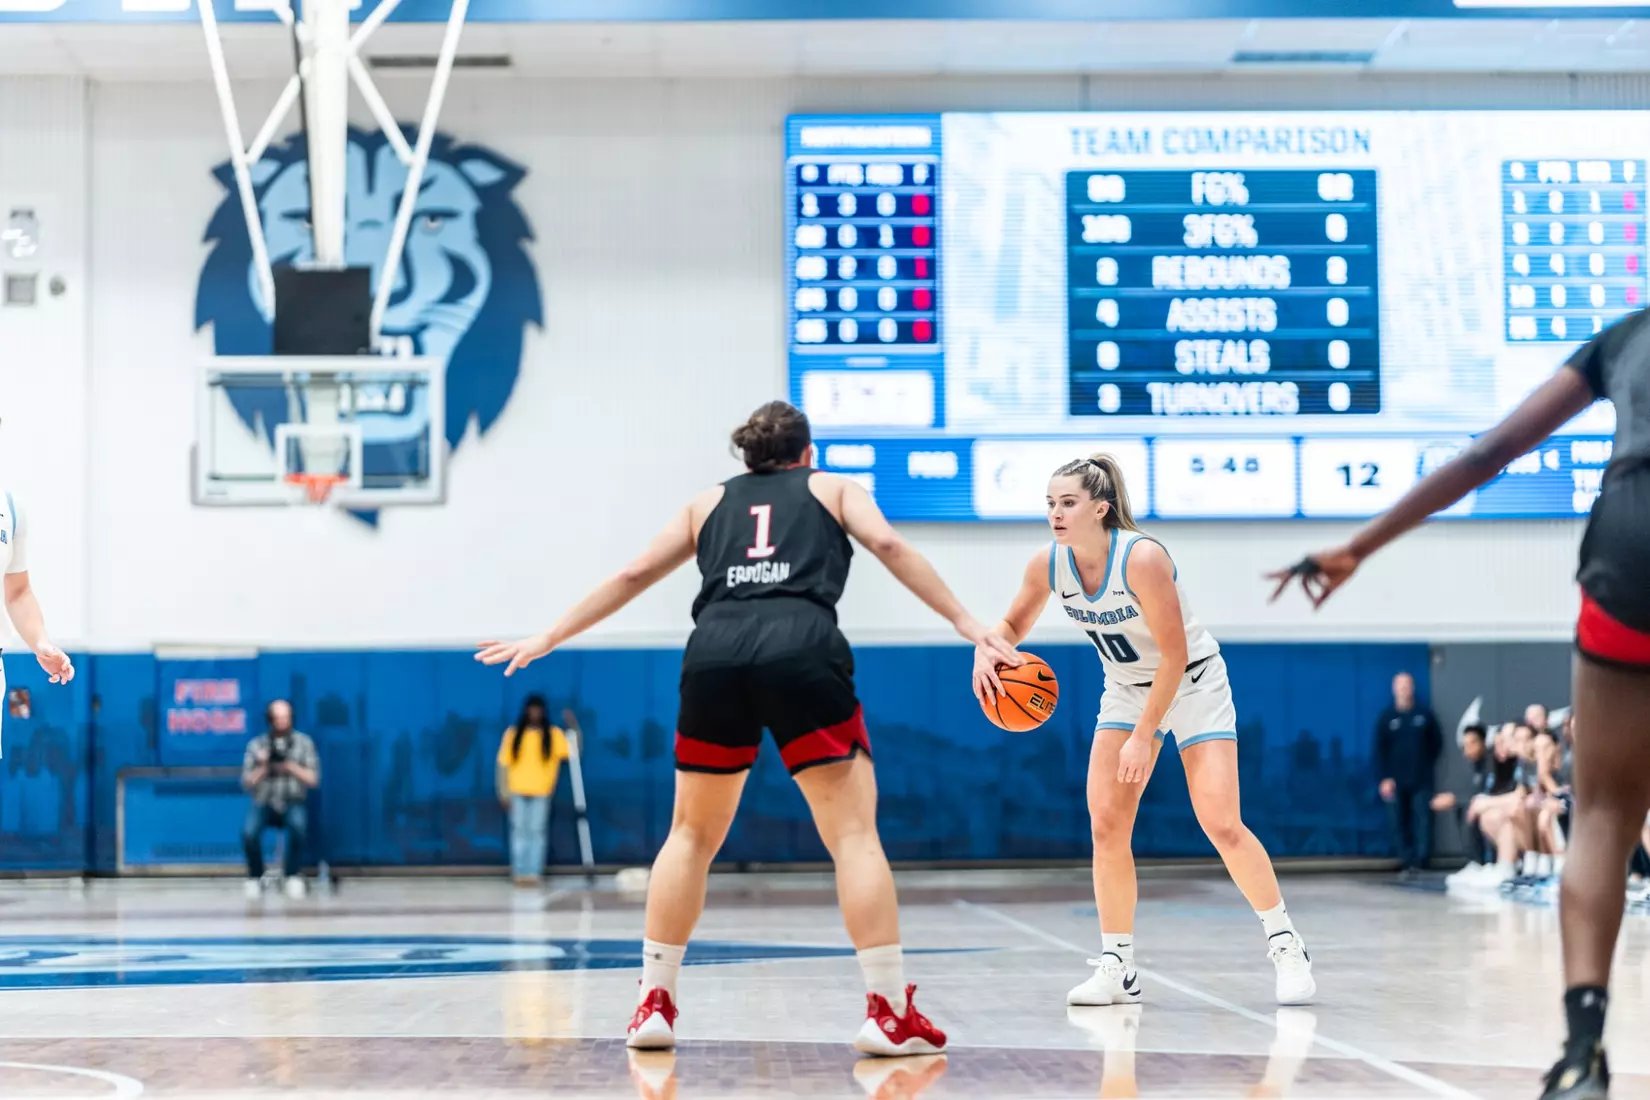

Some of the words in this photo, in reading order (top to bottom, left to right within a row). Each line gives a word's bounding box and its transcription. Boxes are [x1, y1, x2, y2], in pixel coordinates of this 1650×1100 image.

[1069, 127, 1151, 156] TEAM
[1161, 126, 1371, 154] COMPARISON
[1191, 172, 1249, 206] FG%
[1182, 213, 1259, 248] 3FG%
[1152, 255, 1291, 290] REBOUNDS
[1166, 297, 1278, 332] ASSISTS
[1174, 339, 1271, 374] STEALS
[1146, 381, 1300, 415] TURNOVERS
[1337, 462, 1381, 487] 12
[746, 504, 776, 559] 1
[1063, 605, 1139, 625] COLUMBIA
[1084, 629, 1140, 663] 10
